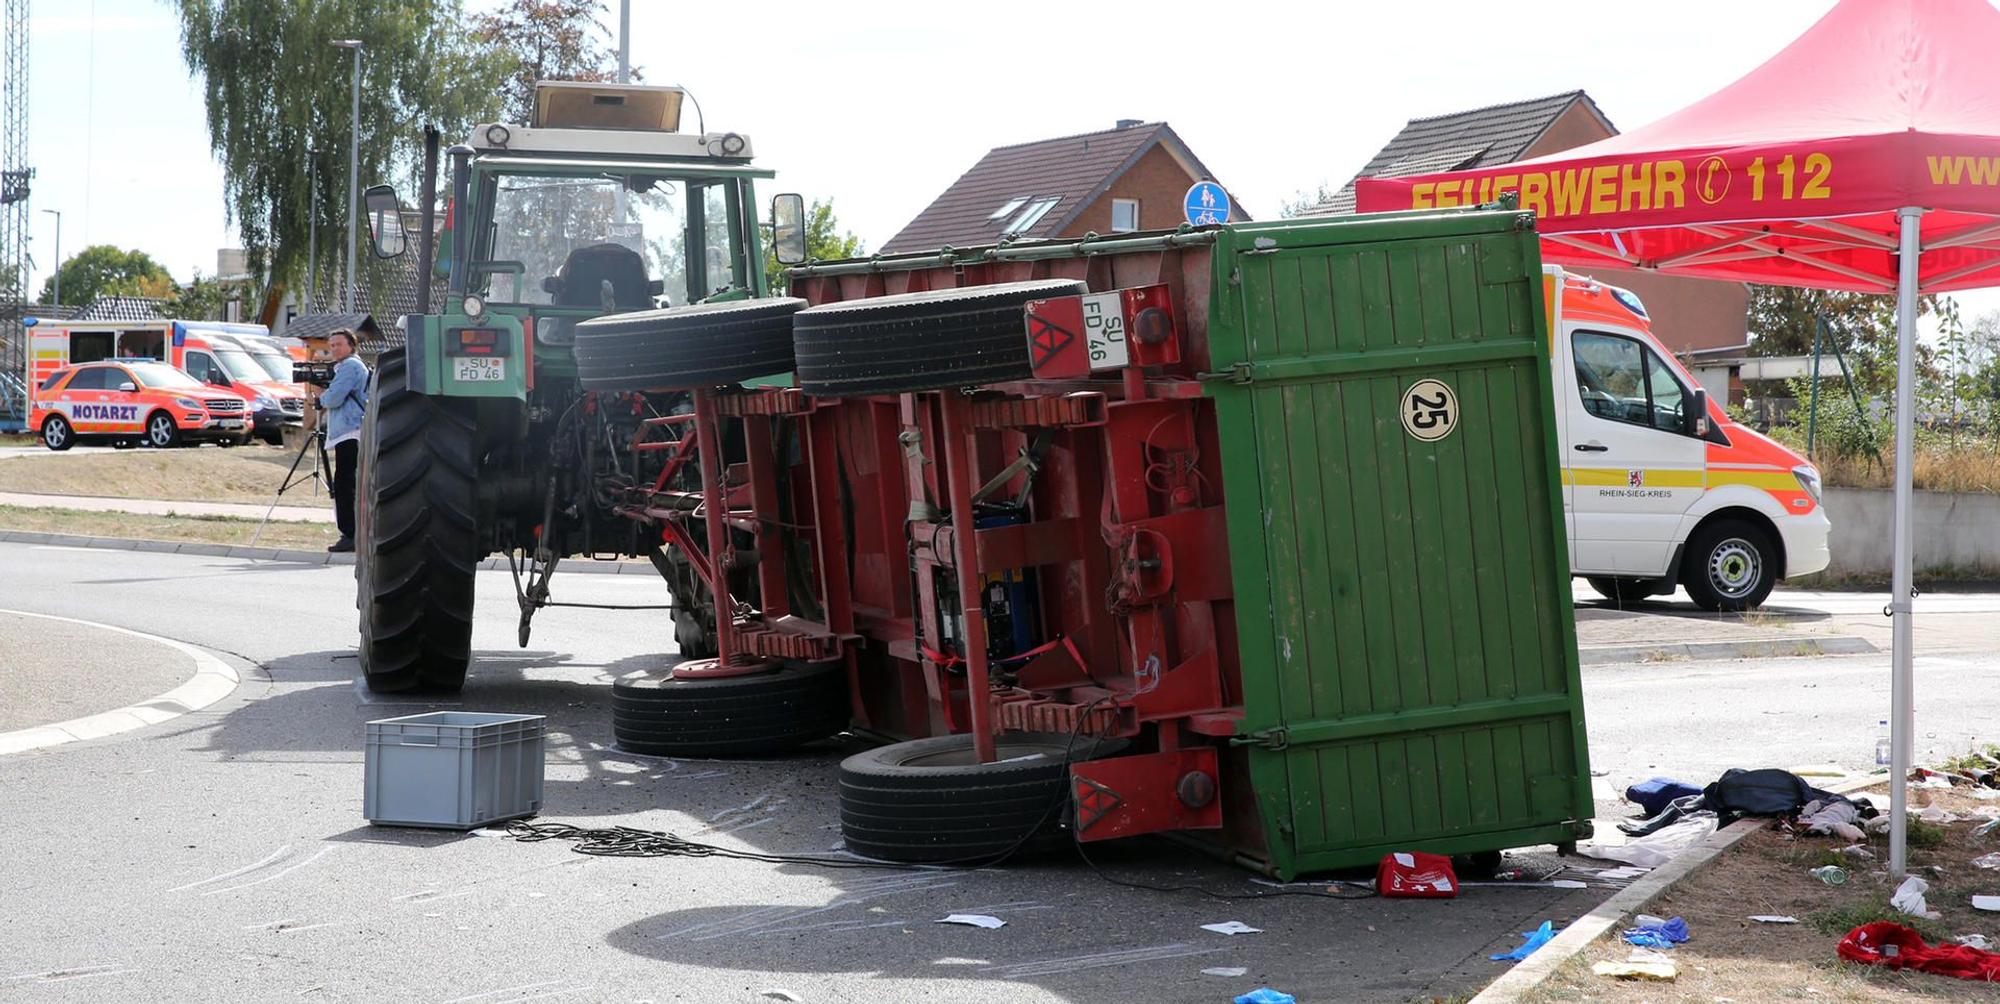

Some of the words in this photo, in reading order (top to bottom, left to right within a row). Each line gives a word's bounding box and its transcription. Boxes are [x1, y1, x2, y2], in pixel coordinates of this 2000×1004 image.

[1746, 152, 1833, 201] 112
[1083, 302, 1102, 328] FD
[1105, 316, 1124, 343] SU
[1089, 340, 1107, 360] 46
[470, 359, 488, 368] SU
[460, 369, 478, 379] FD
[484, 369, 499, 379] 46
[72, 404, 138, 421] NOTARZT
[1411, 391, 1449, 429] 25
[1599, 489, 1672, 498] RHEIN-SIEG-KREIS
